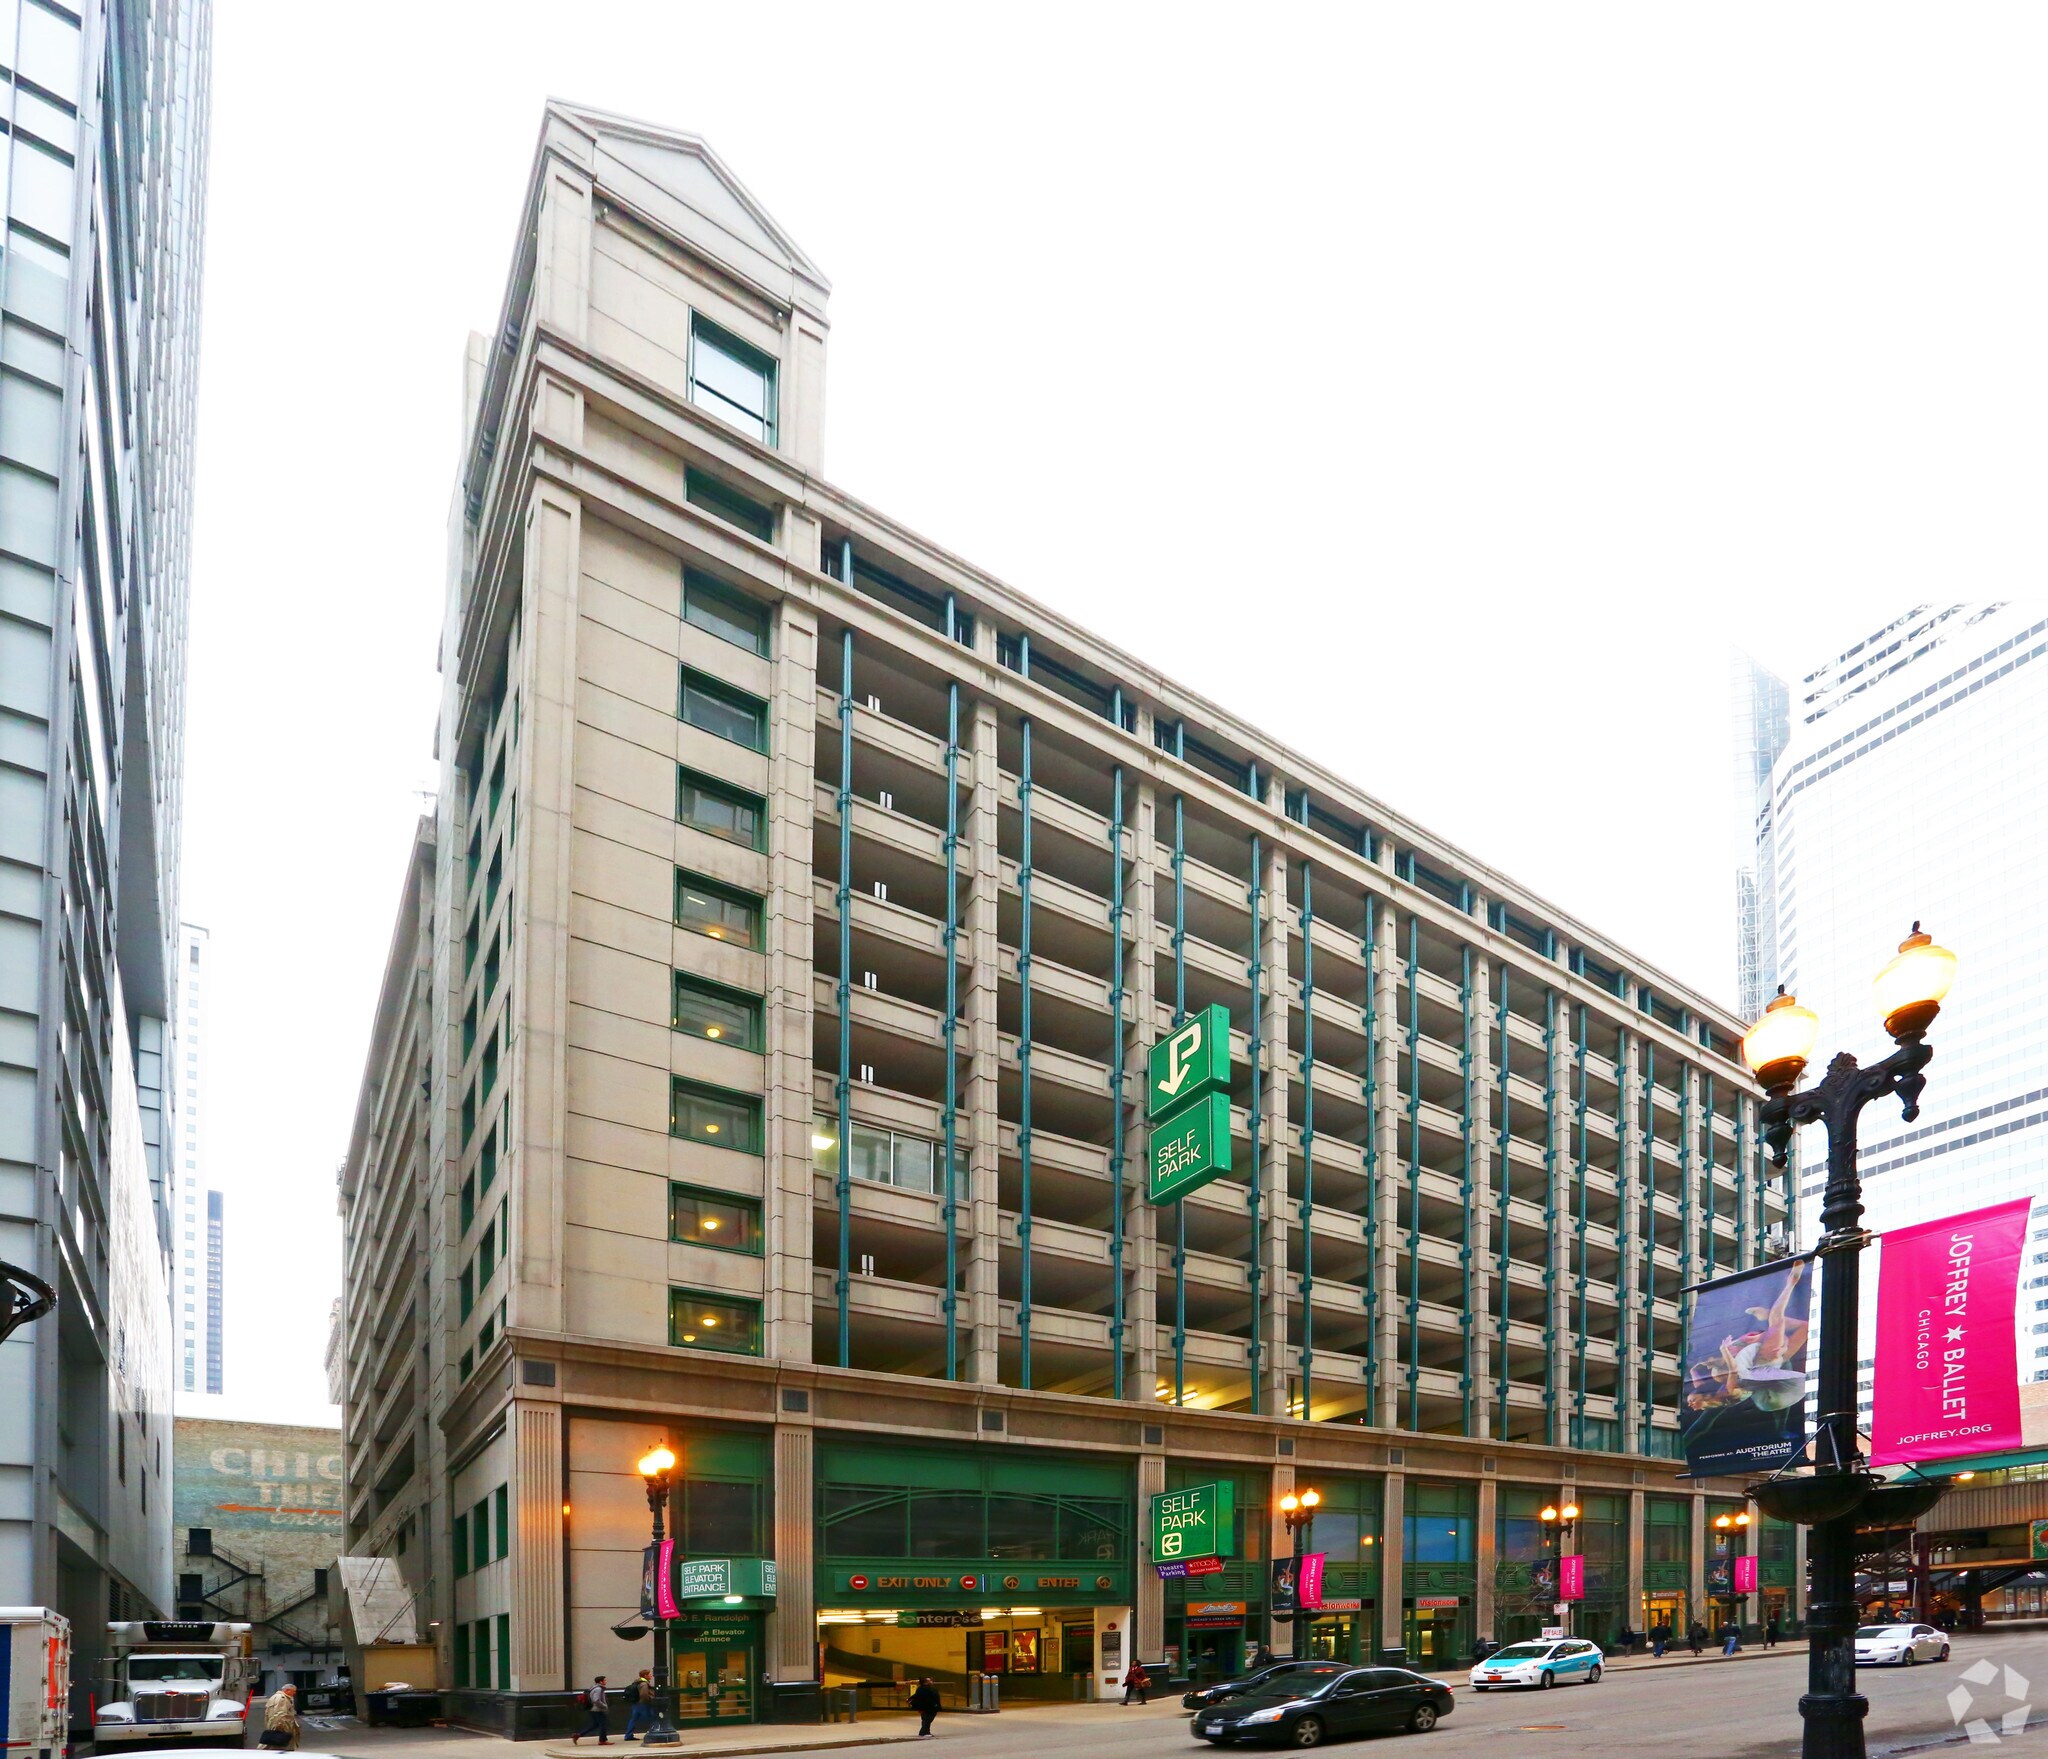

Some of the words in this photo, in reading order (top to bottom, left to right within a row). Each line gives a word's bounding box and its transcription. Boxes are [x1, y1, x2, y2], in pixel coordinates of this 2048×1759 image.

[1158, 1128, 1196, 1164] SELF
[1158, 1144, 1202, 1182] PARK
[1943, 1232, 1974, 1317] JOFFREY
[1916, 1310, 1931, 1370] CHICAGO
[1943, 1347, 1967, 1420] BALLET
[1896, 1424, 1993, 1446] JOFFREY.ORG
[1735, 1441, 1792, 1455] AUDITORIUM
[1752, 1447, 1792, 1458] THEATRE
[1162, 1493, 1200, 1514] SELF
[1161, 1510, 1206, 1532] PARK
[684, 1566, 697, 1575] SELF
[699, 1564, 725, 1573] PARK
[1158, 1564, 1184, 1572] Theatre
[1161, 1569, 1186, 1578] Parking
[685, 1574, 722, 1584] ELEVATOR
[877, 1577, 910, 1588] EXIT
[913, 1577, 952, 1588] ONLY
[1038, 1577, 1080, 1588] ENTER
[684, 1583, 726, 1594] ENTRANCE
[705, 1614, 749, 1622] Randolph
